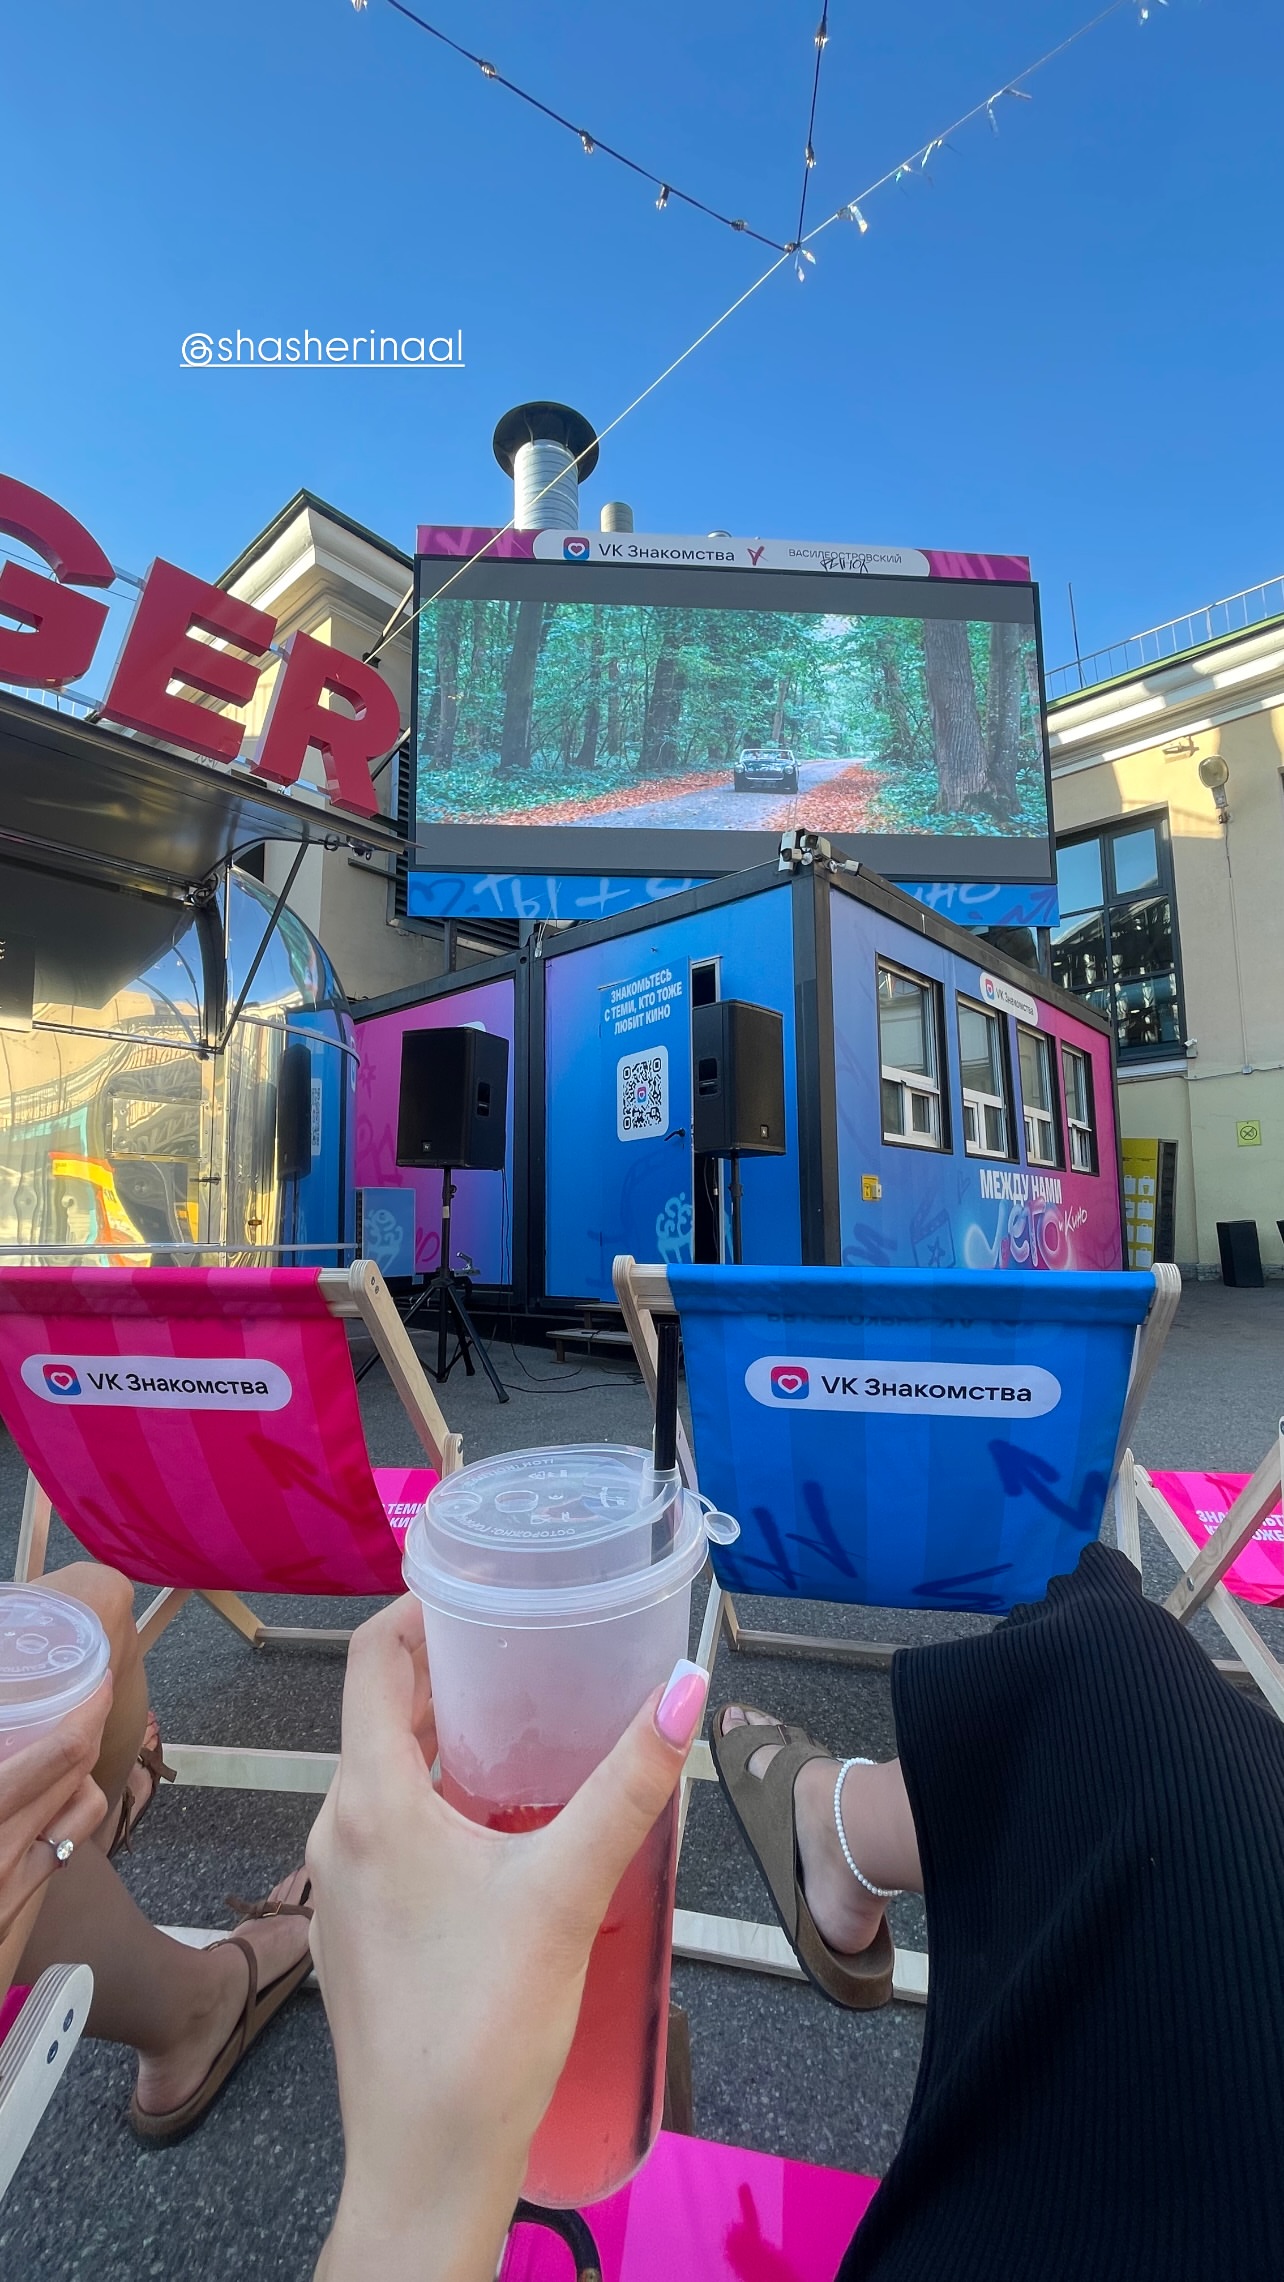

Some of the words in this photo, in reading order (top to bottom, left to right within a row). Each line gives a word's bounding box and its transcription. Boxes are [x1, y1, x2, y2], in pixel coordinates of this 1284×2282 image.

[599, 543, 624, 559] VK
[627, 544, 736, 563] Знакомства
[788, 548, 902, 564] ВАСИЛЕОСТРОВСКИЙ
[610, 968, 672, 1004] ЗНАКОМЬТЕСЬ
[604, 1008, 611, 1022] С
[611, 999, 637, 1019] ТЕМИ,
[638, 991, 656, 1010] КТО
[656, 981, 683, 1003] ТОЖЕ
[614, 1012, 645, 1036] ЛЮБИТ
[645, 1003, 671, 1025] КИНО
[979, 1168, 1029, 1207] МЕЖДУ
[1030, 1175, 1063, 1204] НАМИ
[87, 1372, 122, 1392] VK
[125, 1372, 270, 1396] Знакомства
[821, 1375, 859, 1395] VK
[864, 1378, 1033, 1402] Знакомства
